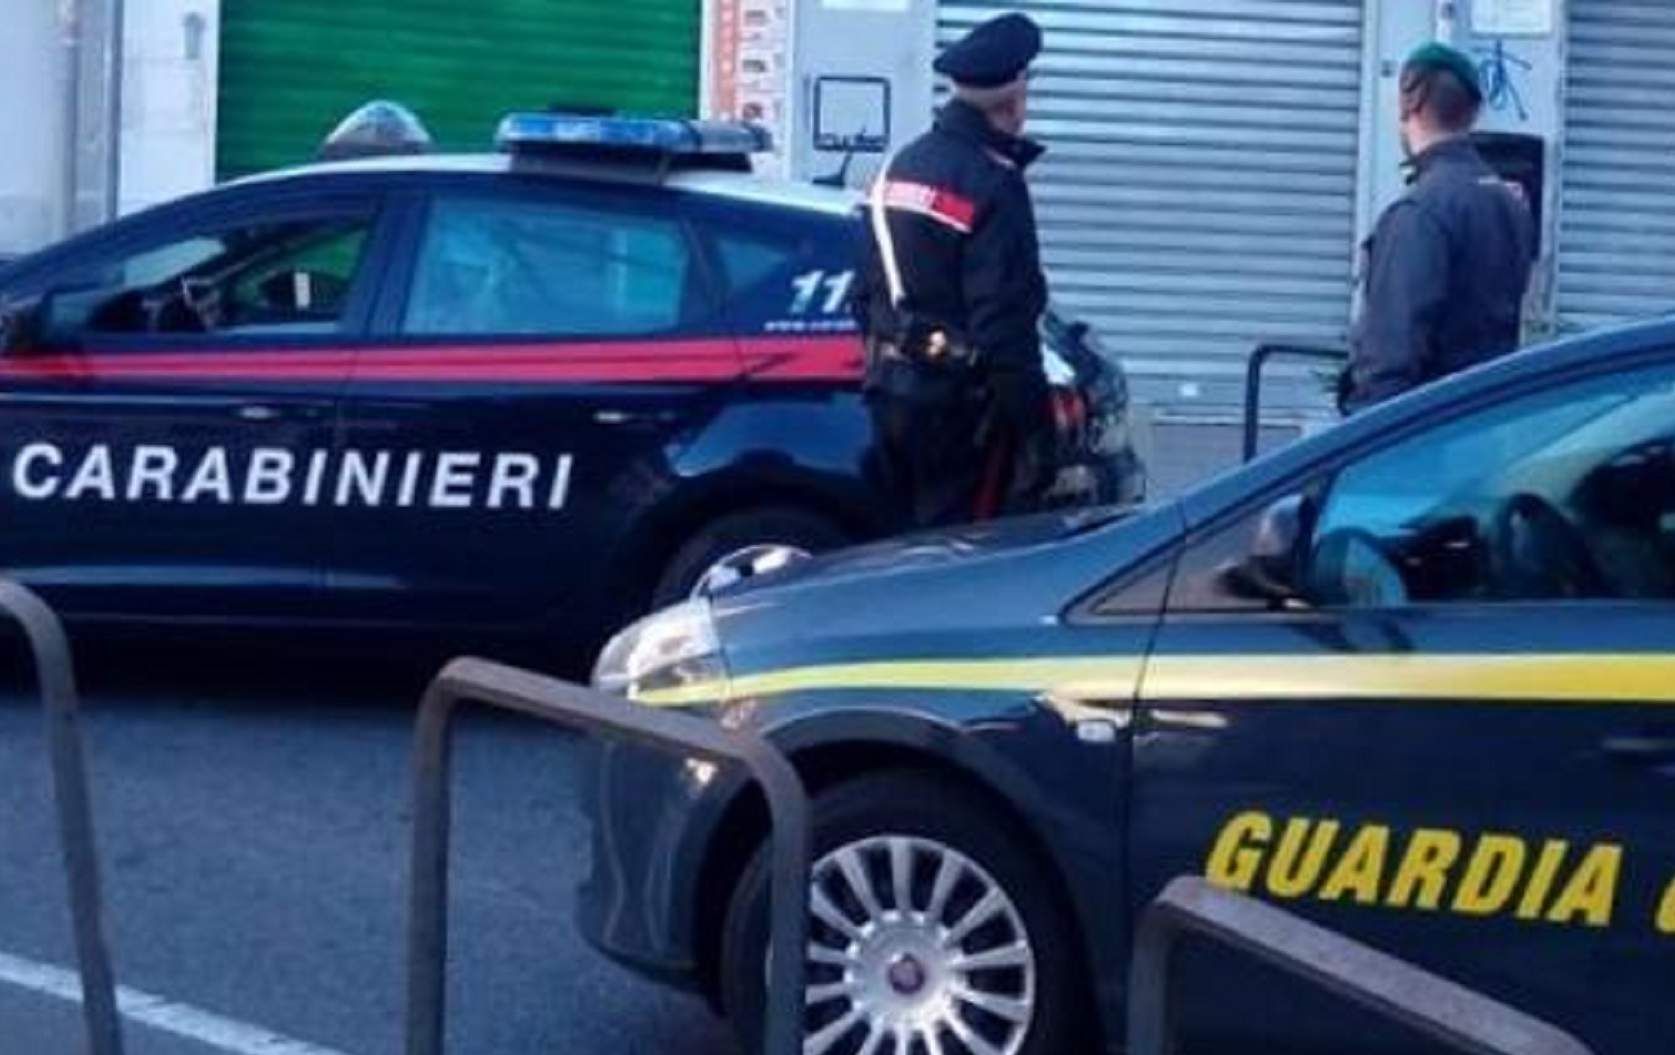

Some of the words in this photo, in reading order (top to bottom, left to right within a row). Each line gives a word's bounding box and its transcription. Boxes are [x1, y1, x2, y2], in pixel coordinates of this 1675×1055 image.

[790, 270, 855, 314] 11
[12, 443, 573, 509] CARABINIERI
[1205, 811, 1622, 926] GUARDIA
